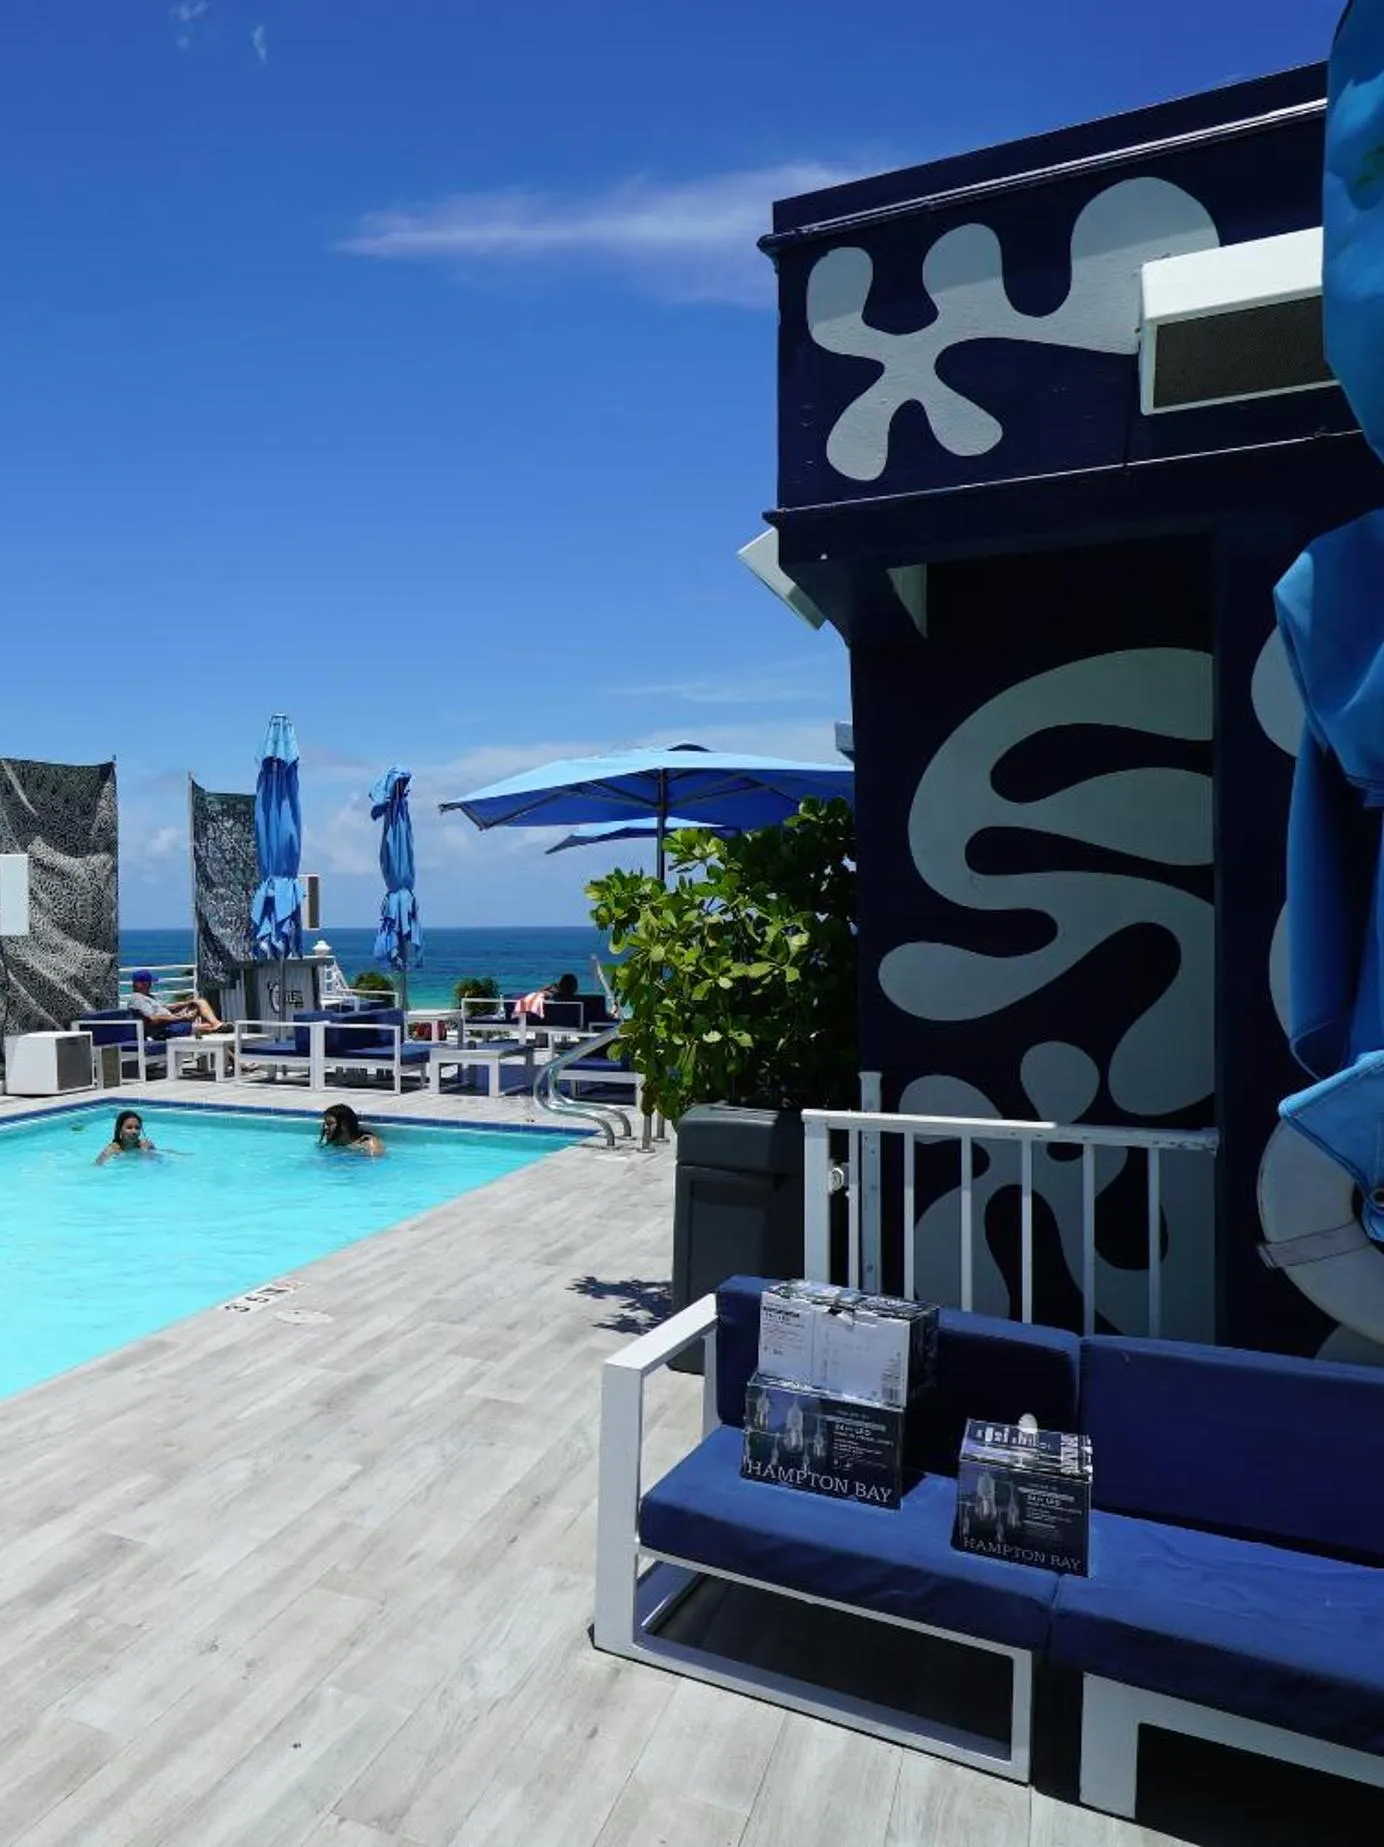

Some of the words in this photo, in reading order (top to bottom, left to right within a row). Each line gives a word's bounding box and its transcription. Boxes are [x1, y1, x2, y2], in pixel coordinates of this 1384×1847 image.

[748, 1460, 849, 1494] HAMPTON
[855, 1480, 892, 1503] BAY
[964, 1536, 1046, 1563] HAMPTON
